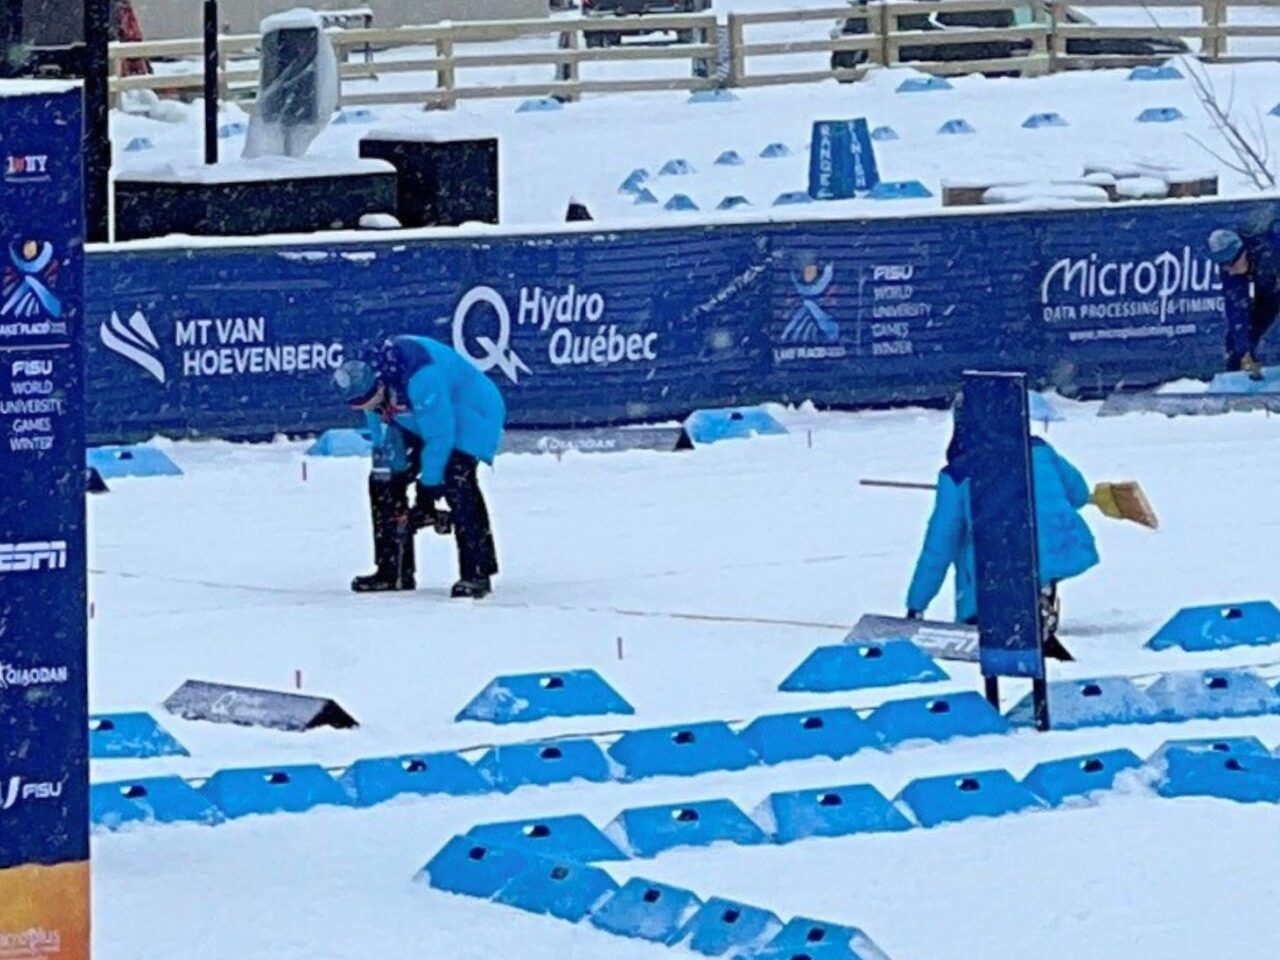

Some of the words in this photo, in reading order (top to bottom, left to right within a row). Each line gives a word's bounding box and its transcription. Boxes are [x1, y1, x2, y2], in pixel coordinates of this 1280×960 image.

[873, 265, 914, 280] FISU
[518, 286, 605, 331] Hydro
[1043, 306, 1077, 322] DATA
[1080, 301, 1160, 319] PROCESSING
[1179, 297, 1226, 313] TIMING
[174, 318, 212, 347] MT
[216, 317, 265, 342] VAN
[548, 324, 658, 365] Québec
[11, 360, 53, 375] FISU
[184, 341, 344, 376] HOEVENBERG
[11, 379, 54, 394] WORLD
[0, 398, 63, 415] UNIVERSITY
[12, 418, 52, 432] GAMES
[10, 436, 54, 451] WINTER
[6, 664, 68, 686] QIAODAN
[22, 782, 62, 800] FISU
